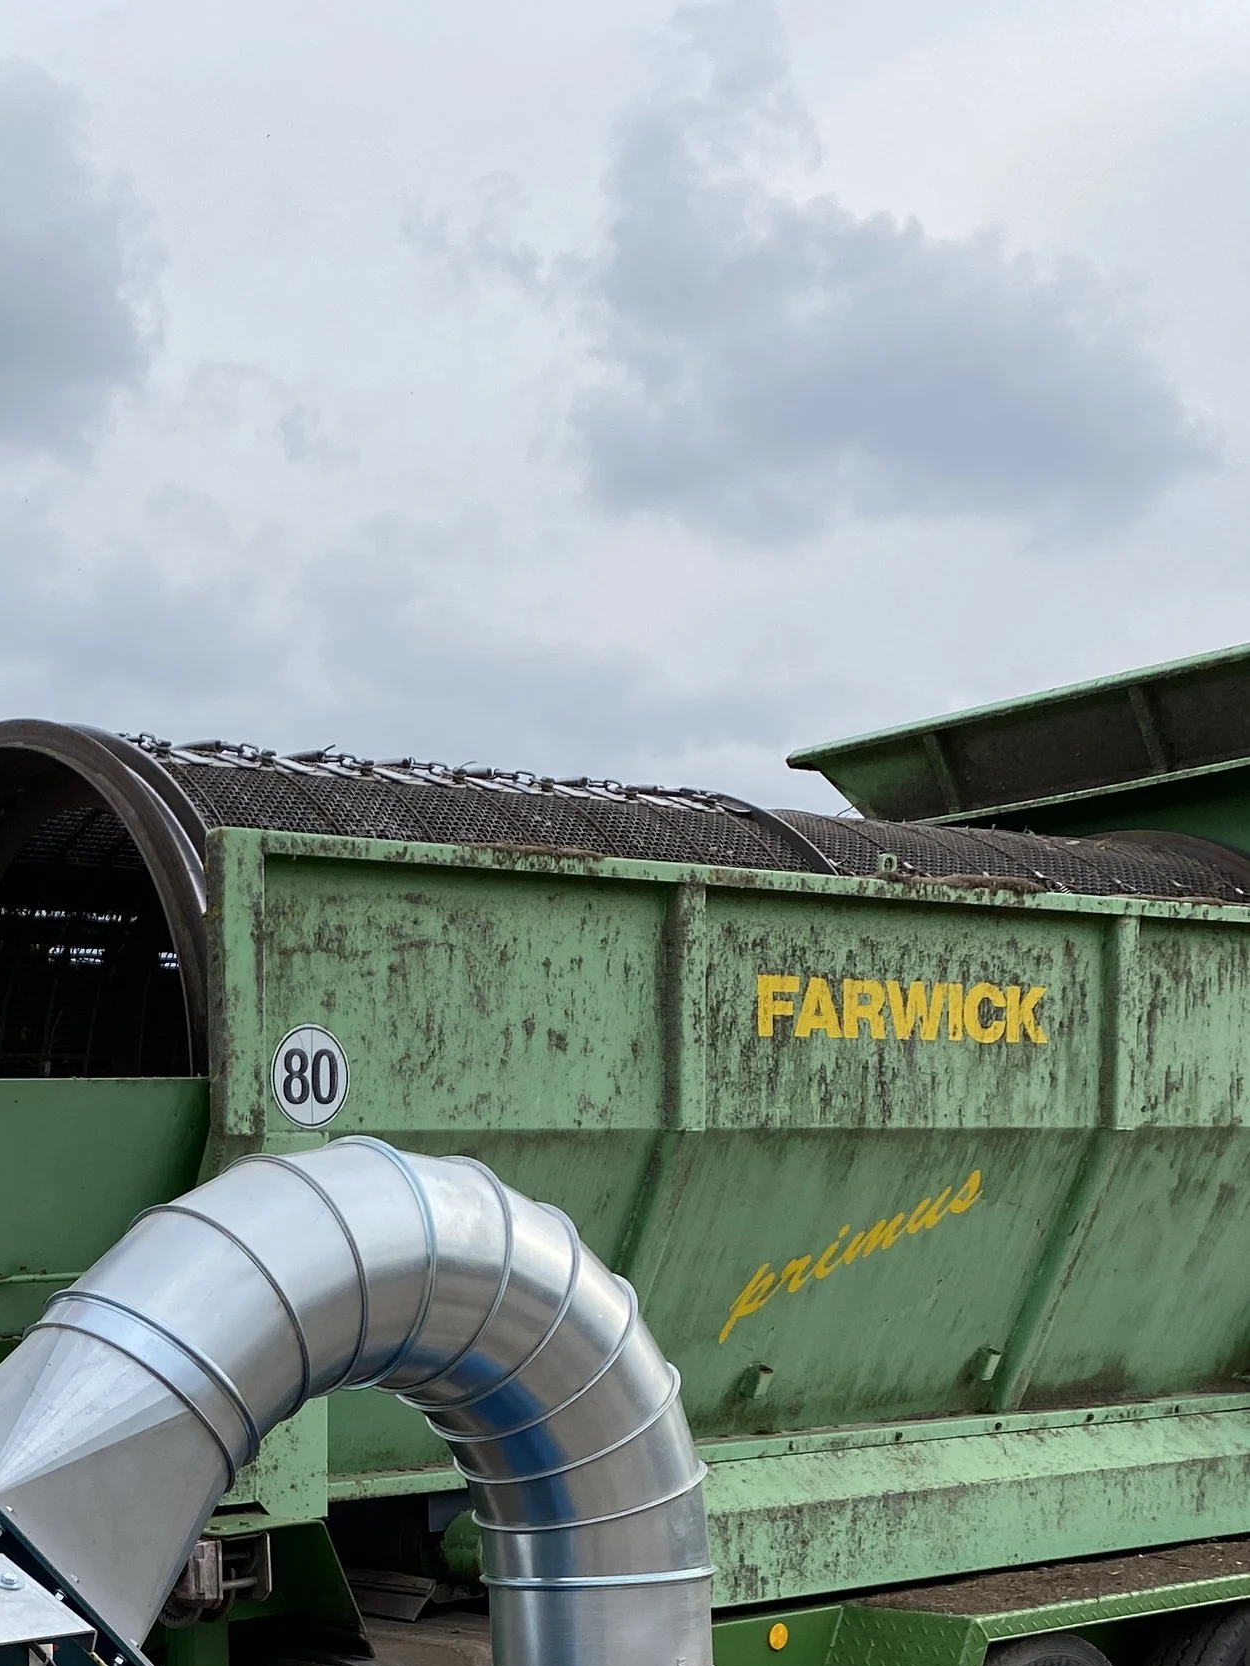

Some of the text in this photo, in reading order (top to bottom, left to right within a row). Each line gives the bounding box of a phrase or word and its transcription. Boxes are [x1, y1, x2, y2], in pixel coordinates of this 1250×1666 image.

[757, 974, 1049, 1044] FARWICK
[283, 1048, 338, 1105] 80
[718, 1169, 983, 1343] primus
